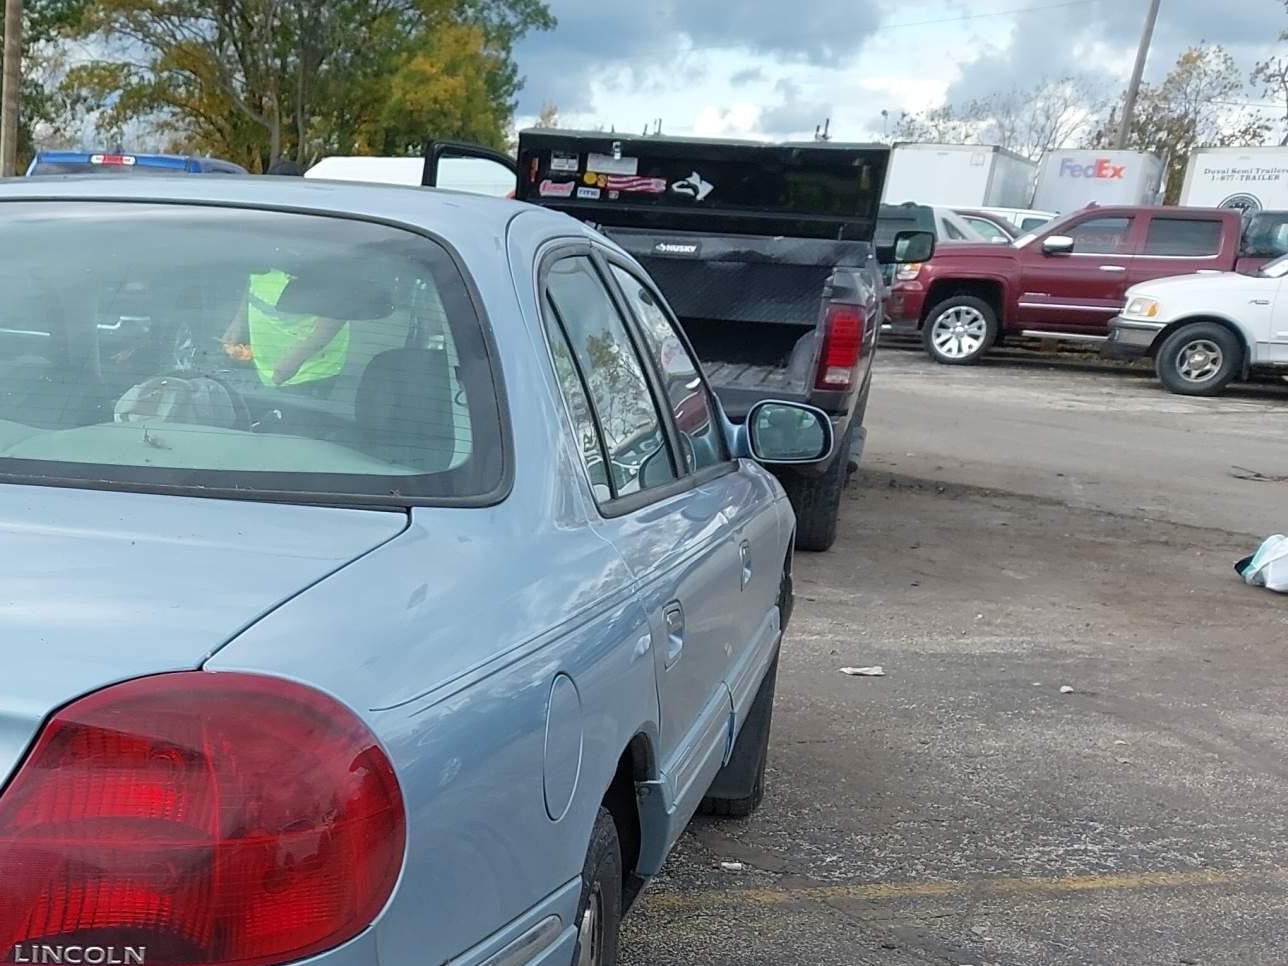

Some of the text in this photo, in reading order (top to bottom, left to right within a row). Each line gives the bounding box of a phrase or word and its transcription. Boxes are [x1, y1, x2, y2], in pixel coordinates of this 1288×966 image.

[1059, 158, 1126, 179] FedEx
[666, 243, 697, 253] HUSKY
[14, 944, 146, 965] LINCOLN
